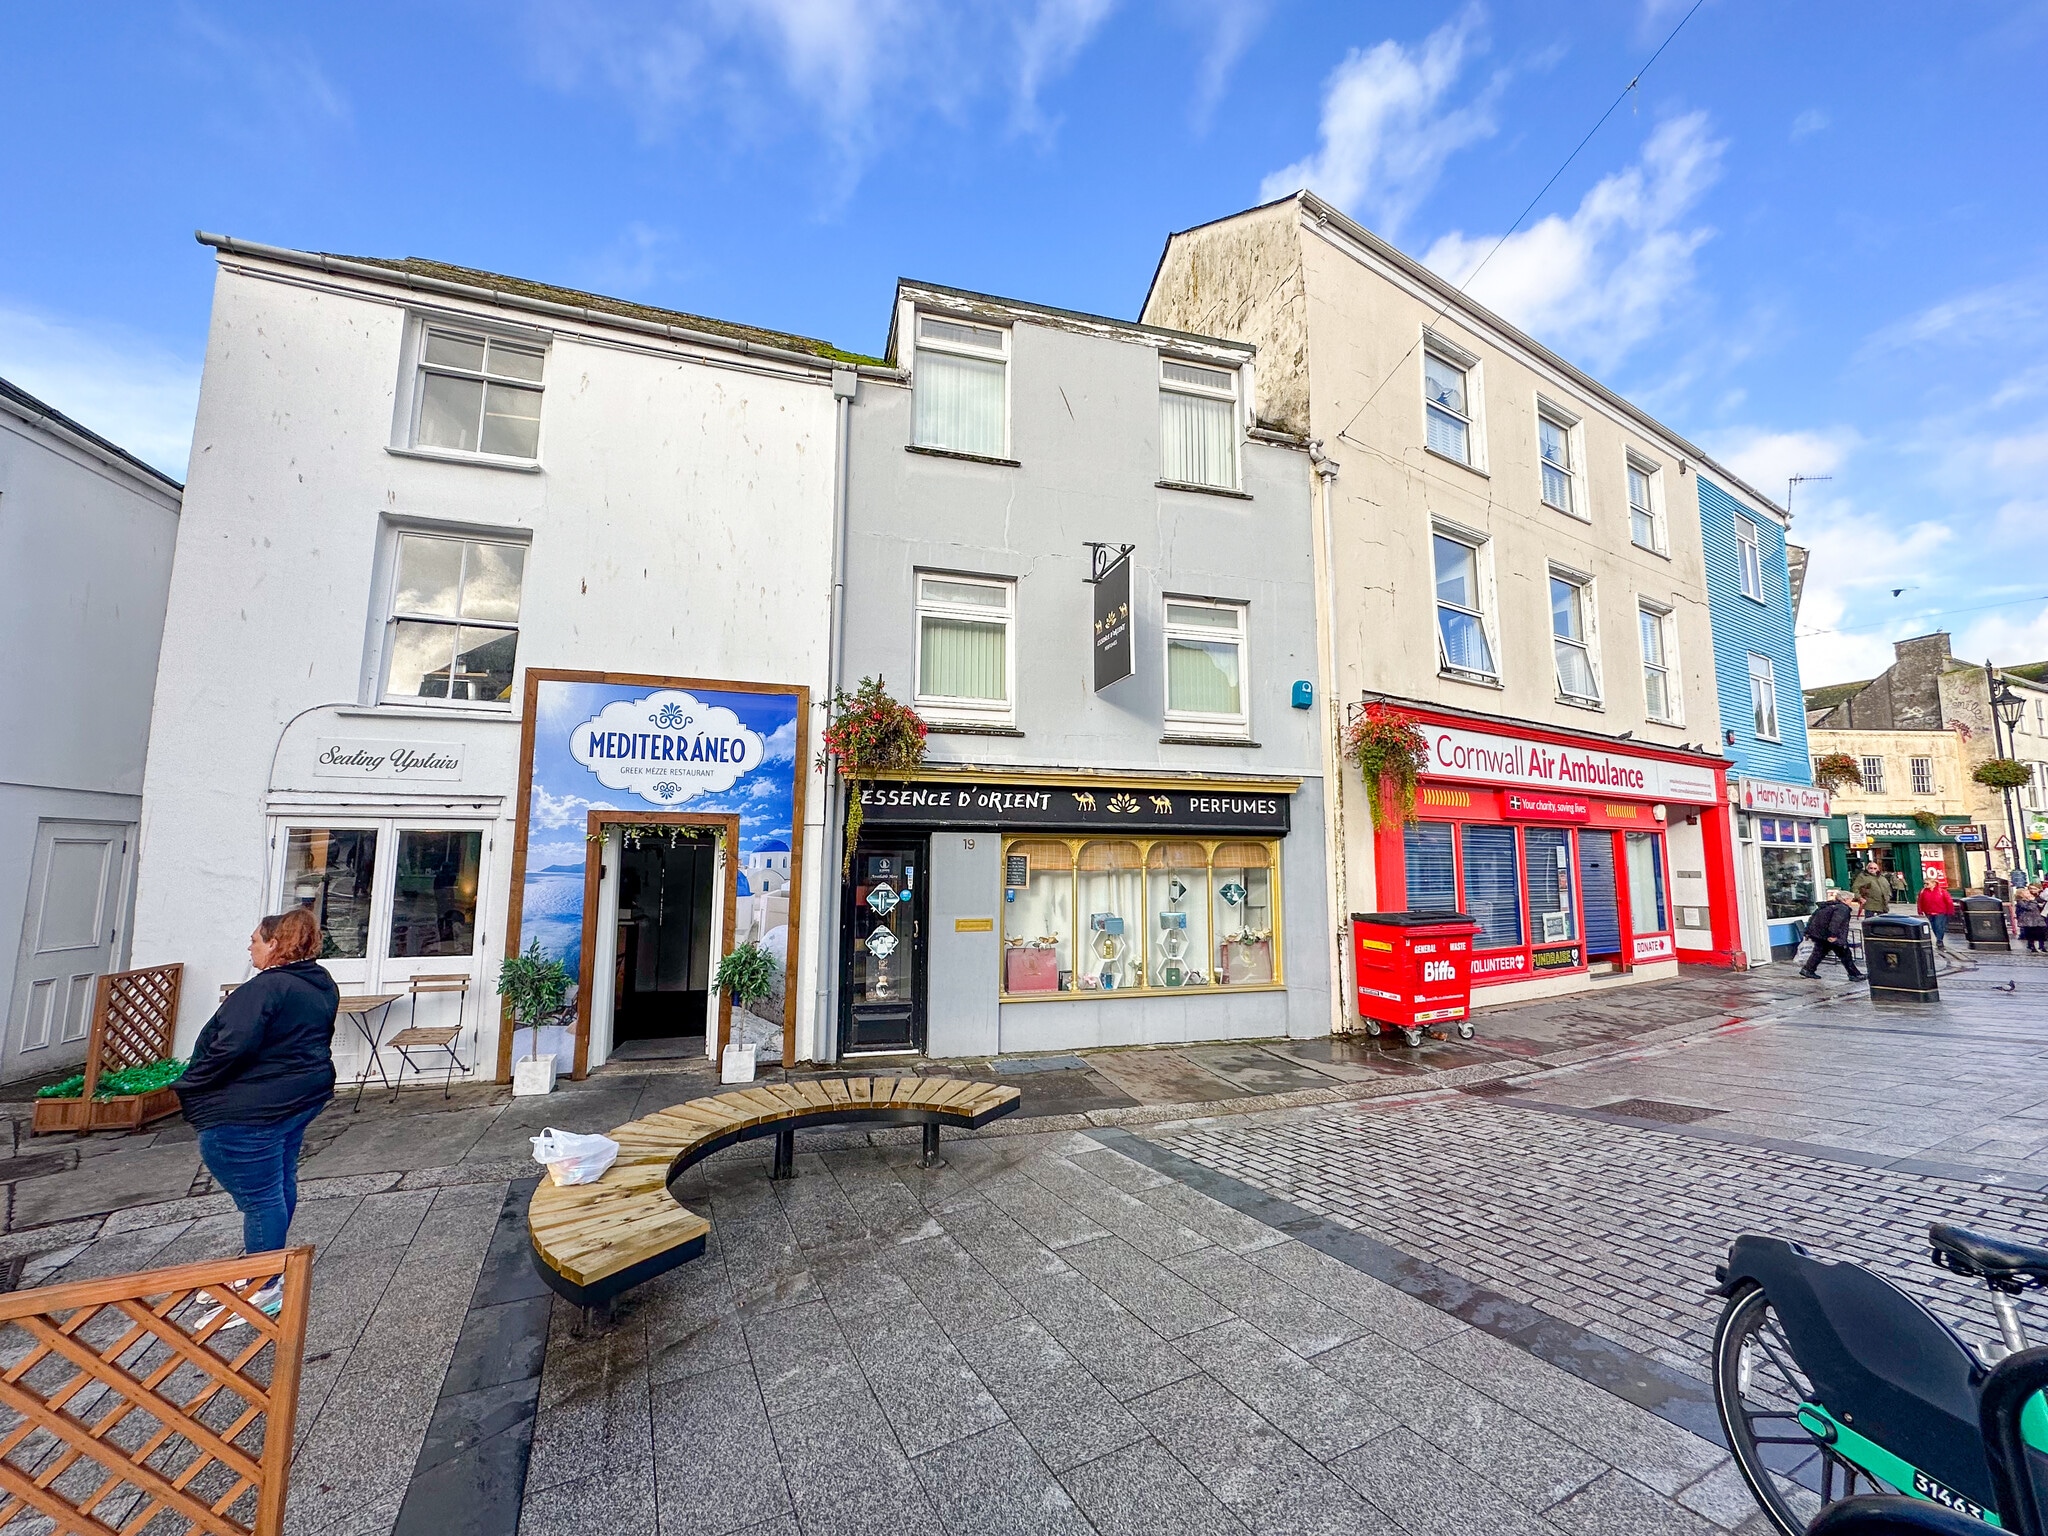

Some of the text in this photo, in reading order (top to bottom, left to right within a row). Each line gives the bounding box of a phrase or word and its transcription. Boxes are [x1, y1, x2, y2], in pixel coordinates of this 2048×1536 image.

[588, 731, 746, 763] MEDITERRÁNEO
[319, 745, 459, 773] Seating Upstairs
[1436, 734, 1644, 789] Cornwall Air Ambulance
[620, 766, 644, 775] GREEK
[669, 768, 715, 777] RESTAURANT
[860, 788, 952, 807] ESSENCE
[1189, 797, 1277, 814] PERFUMES
[1521, 798, 1586, 814] Your charity, saving lives
[1756, 783, 1820, 810] Harry's Toy Chest
[962, 838, 975, 850] 19
[1921, 850, 1939, 858] ALE
[1414, 942, 1466, 954] GENERAL WASTE
[1636, 941, 1659, 953] DONATE
[1424, 960, 1456, 982] Biffa
[1915, 1473, 1981, 1519] 31463
